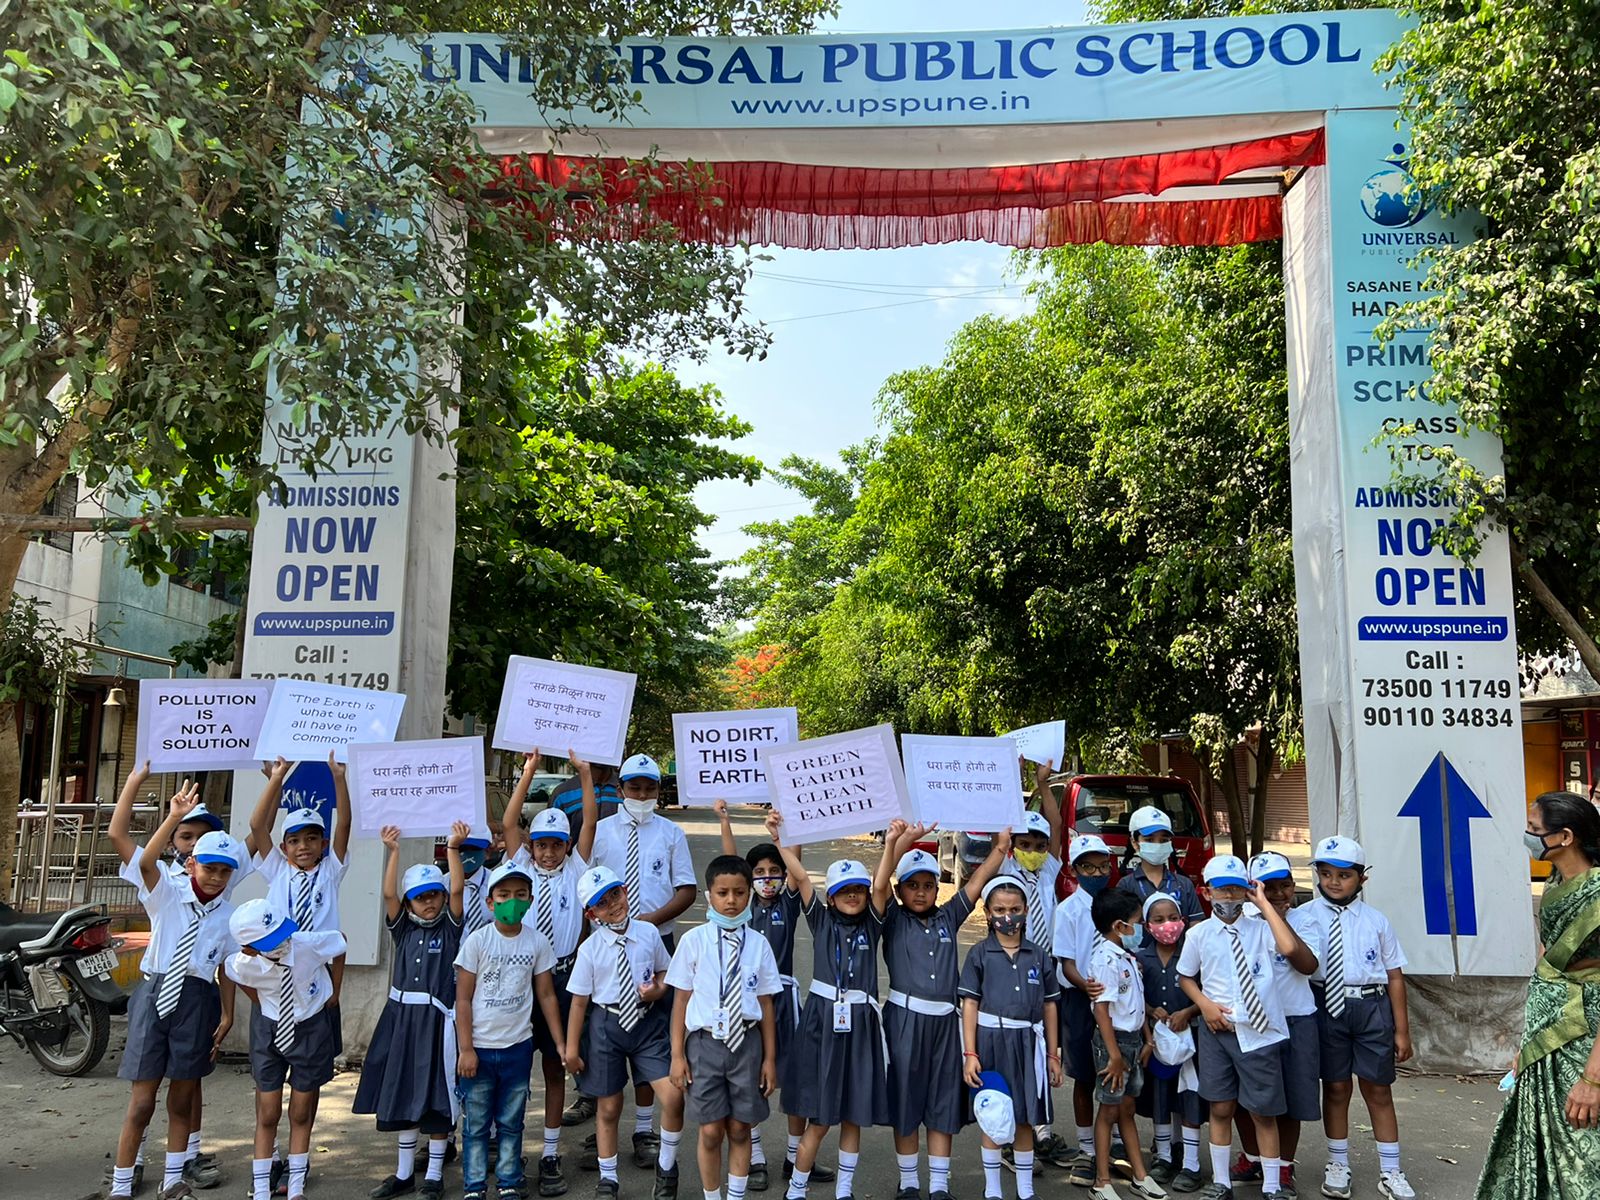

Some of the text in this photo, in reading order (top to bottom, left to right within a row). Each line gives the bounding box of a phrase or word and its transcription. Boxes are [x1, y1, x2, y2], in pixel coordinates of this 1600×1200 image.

[419, 22, 1361, 84] UNIERSAL PUBLIC SCHOOL
[731, 91, 1030, 118] www.upspune.in
[1362, 232, 1460, 246] UNIVERSAL
[1361, 248, 1405, 256] PUBLIC
[1347, 281, 1412, 292] SASANE
[348, 447, 393, 464] UKG
[1402, 444, 1434, 461] TO
[268, 486, 400, 507] ADMISSIONS
[285, 517, 377, 554] NOW
[276, 564, 379, 602] OPEN
[1375, 567, 1486, 606] OPEN
[261, 616, 388, 632] www.upspune.in
[1365, 621, 1502, 637] www.upspune.in
[295, 645, 335, 663] Call
[1406, 650, 1449, 669] Call
[1362, 679, 1511, 698] 73500 11749
[159, 695, 256, 705] POLLUTION
[323, 697, 362, 709] Earth
[365, 702, 376, 711] is
[197, 710, 213, 720] IS
[300, 707, 356, 720] what we
[1364, 707, 1513, 727] 90110 34834
[181, 724, 232, 735] NOT A
[291, 720, 357, 733] all have in
[691, 726, 778, 743] NO DIRT,
[162, 738, 250, 750] SOLUTION
[699, 748, 747, 763] THIS
[786, 749, 861, 772] GREEN
[373, 767, 390, 776] धरा
[417, 763, 439, 777] होगी
[442, 763, 454, 774] तो
[927, 761, 942, 770] धरा
[966, 760, 984, 772] होगी
[987, 761, 997, 772] तो
[699, 769, 766, 784] EARTH
[792, 766, 865, 788] EARTH
[390, 787, 407, 796] धरा
[410, 786, 423, 797] रह
[425, 785, 458, 795] जाएगा
[797, 782, 867, 804] CLEAN
[945, 781, 959, 790] धरा
[962, 782, 973, 792] रह
[975, 783, 1002, 792] जाएगा
[801, 798, 874, 821] EARTH
